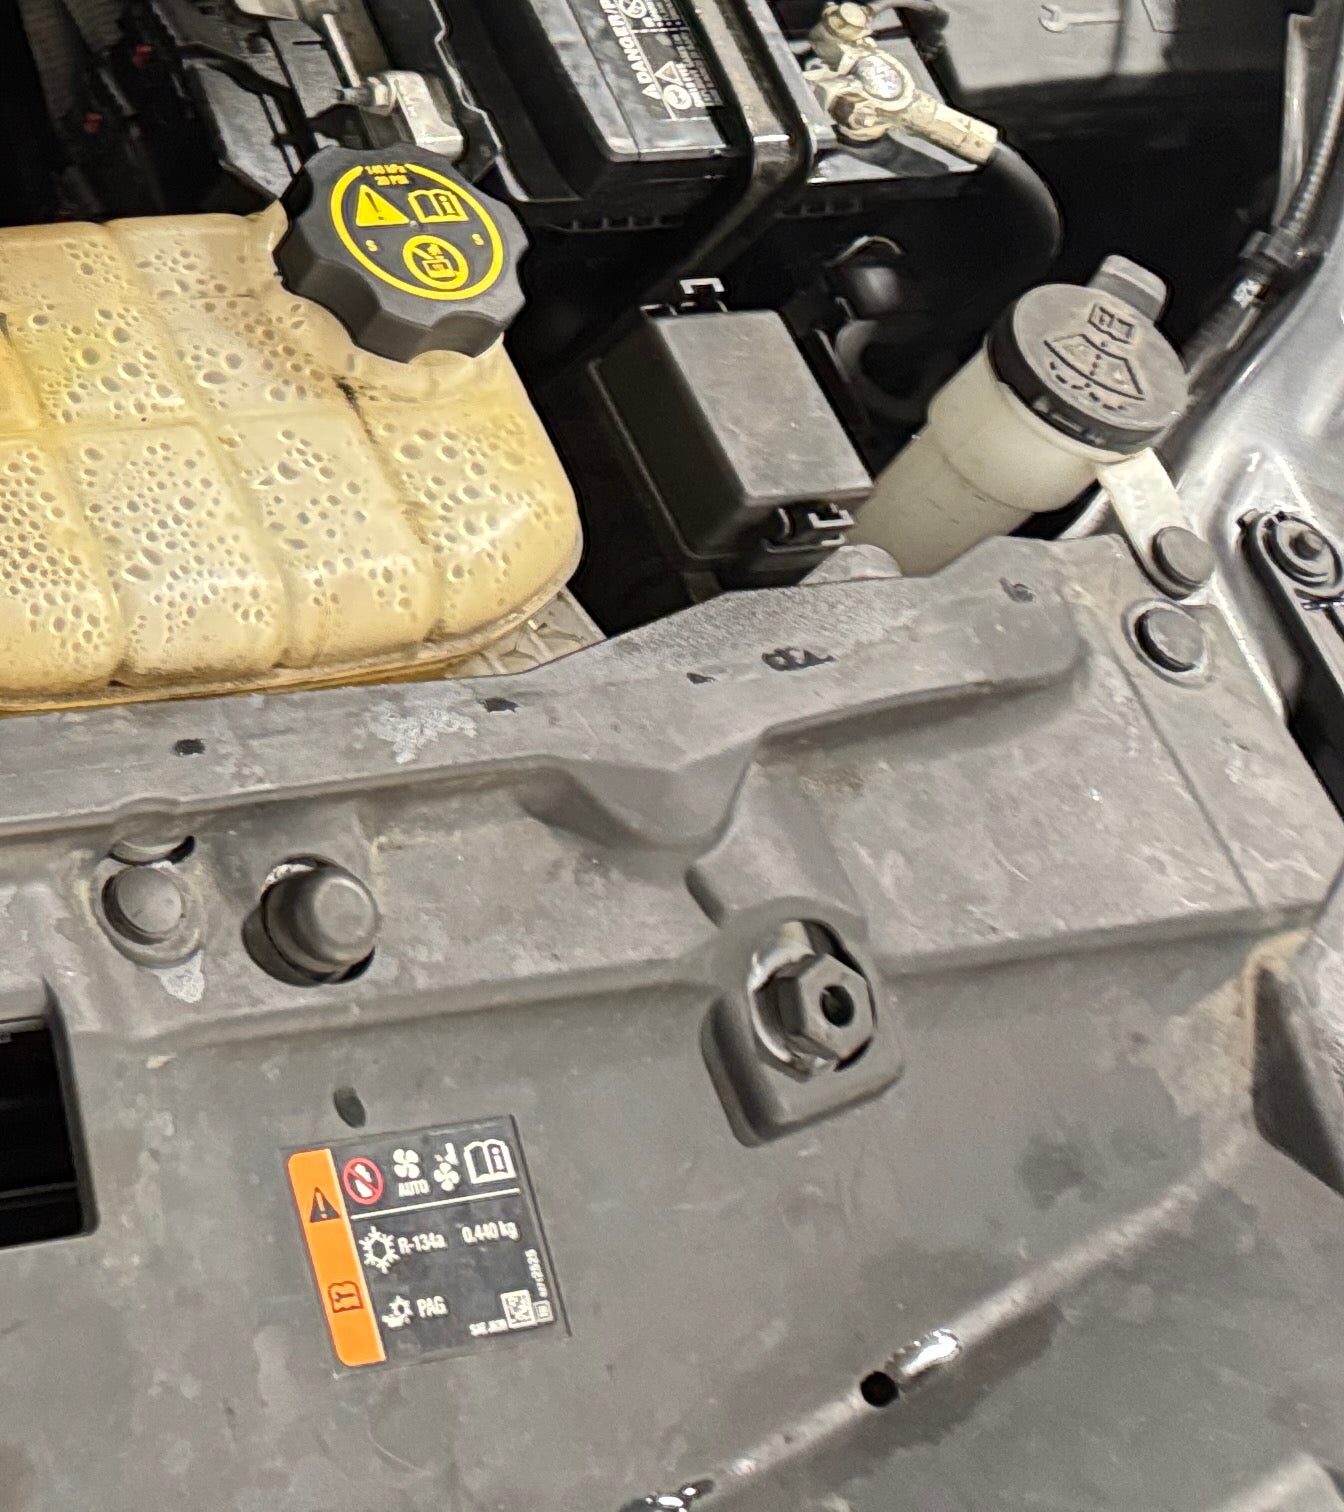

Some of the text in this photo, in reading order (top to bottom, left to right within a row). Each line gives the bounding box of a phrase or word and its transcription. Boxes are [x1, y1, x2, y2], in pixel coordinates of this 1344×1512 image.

[498, 1220, 519, 1241] kg
[398, 1232, 448, 1255] R-134a
[416, 1295, 448, 1318] PAG
